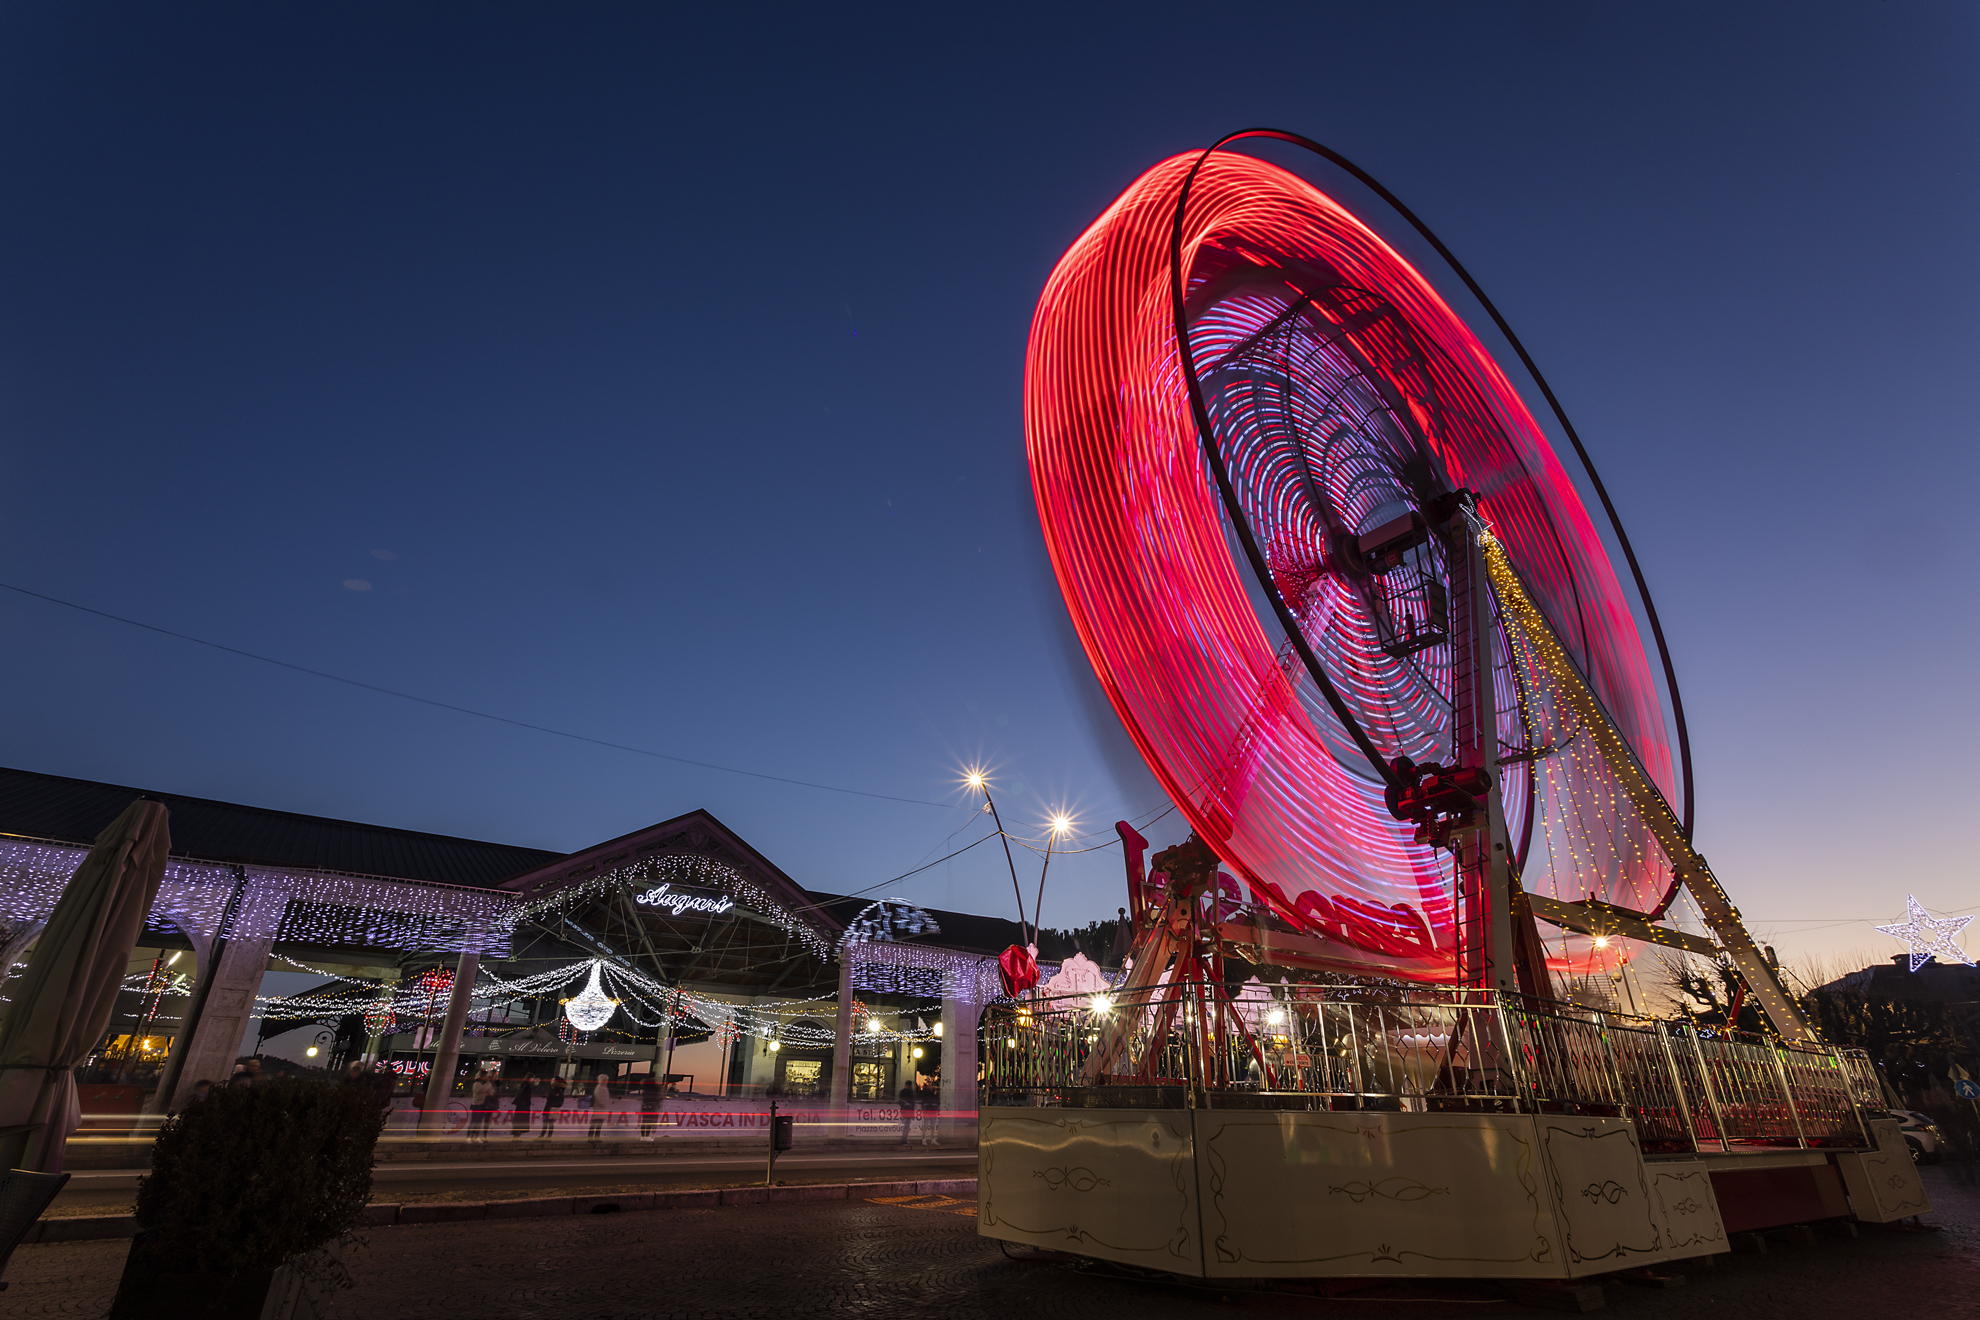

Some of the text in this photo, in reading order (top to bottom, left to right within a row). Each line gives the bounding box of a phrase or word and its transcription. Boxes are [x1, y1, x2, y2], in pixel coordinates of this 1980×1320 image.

[636, 883, 734, 915] Auguri
[602, 1045, 635, 1056] Pizzeria
[606, 1111, 630, 1127] LA
[675, 1112, 735, 1127] VASCA
[738, 1112, 756, 1127] IN
[856, 1108, 876, 1121] Tel.
